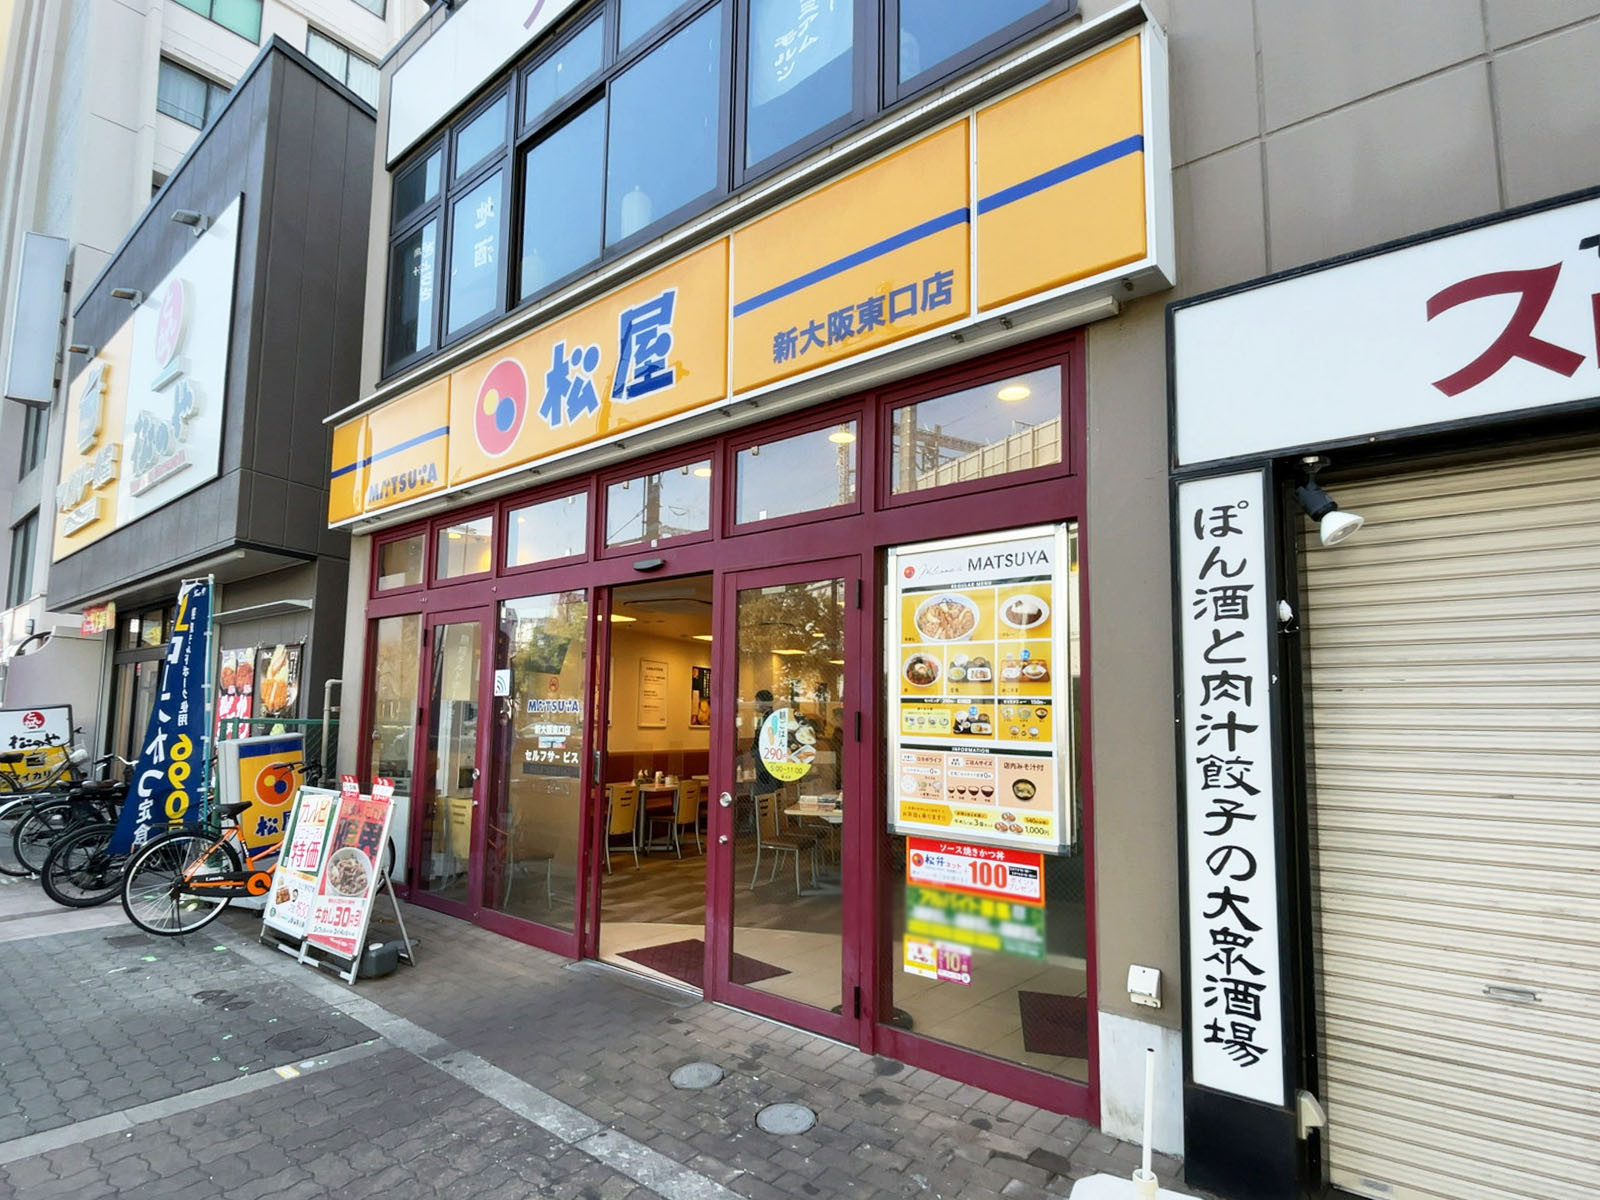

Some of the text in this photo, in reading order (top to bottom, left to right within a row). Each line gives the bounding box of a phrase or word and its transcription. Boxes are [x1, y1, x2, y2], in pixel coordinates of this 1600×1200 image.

[772, 269, 954, 364] 新大阪東口店
[1426, 260, 1600, 398] ス
[537, 287, 679, 430] 松屋
[368, 461, 438, 503] MATSUYA
[967, 549, 1050, 572] MATSUYA
[527, 699, 580, 713] MATSUYA
[525, 749, 579, 764] セルフサービス
[951, 746, 990, 754] INFORMATION
[1192, 500, 1270, 1068] ぽん酒と肉汁餃子の大衆酒場
[939, 843, 1006, 862] ソース焼きかつ丼
[968, 860, 1007, 889] 100
